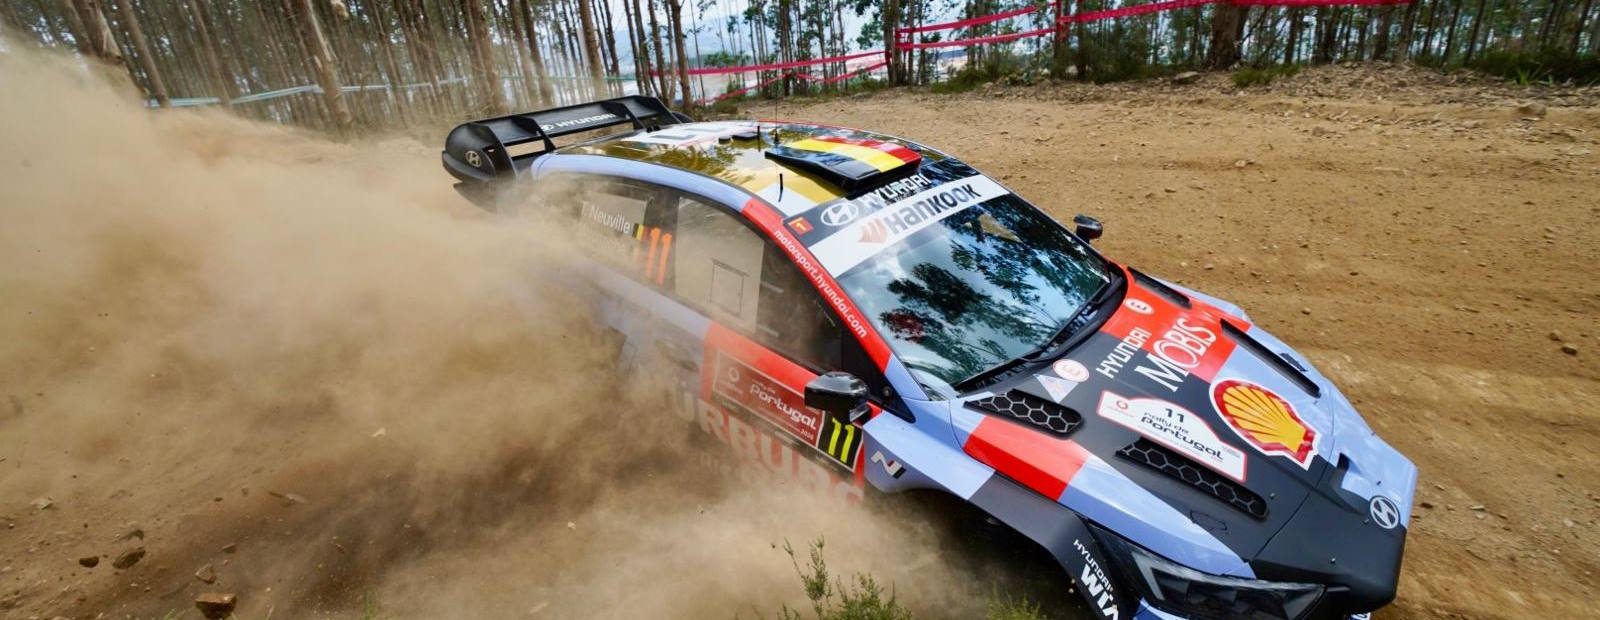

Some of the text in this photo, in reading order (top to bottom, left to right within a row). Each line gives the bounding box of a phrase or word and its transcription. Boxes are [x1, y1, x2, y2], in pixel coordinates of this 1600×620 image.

[555, 113, 616, 128] HYUNDAI
[858, 172, 932, 208] HYUNDAI
[591, 205, 631, 234] Neuville
[645, 227, 672, 286] 11
[774, 230, 868, 338] motorsport.hyundai.com
[1095, 326, 1153, 379] HYUNDAI
[1134, 317, 1217, 393] MOBIS
[751, 383, 817, 430] Portugal
[1144, 411, 1174, 430] rally
[1174, 424, 1190, 435] de
[1165, 407, 1185, 423] 11
[828, 417, 855, 463] 11
[1141, 416, 1224, 460] Portugal
[1073, 539, 1112, 591] HYUNDAI
